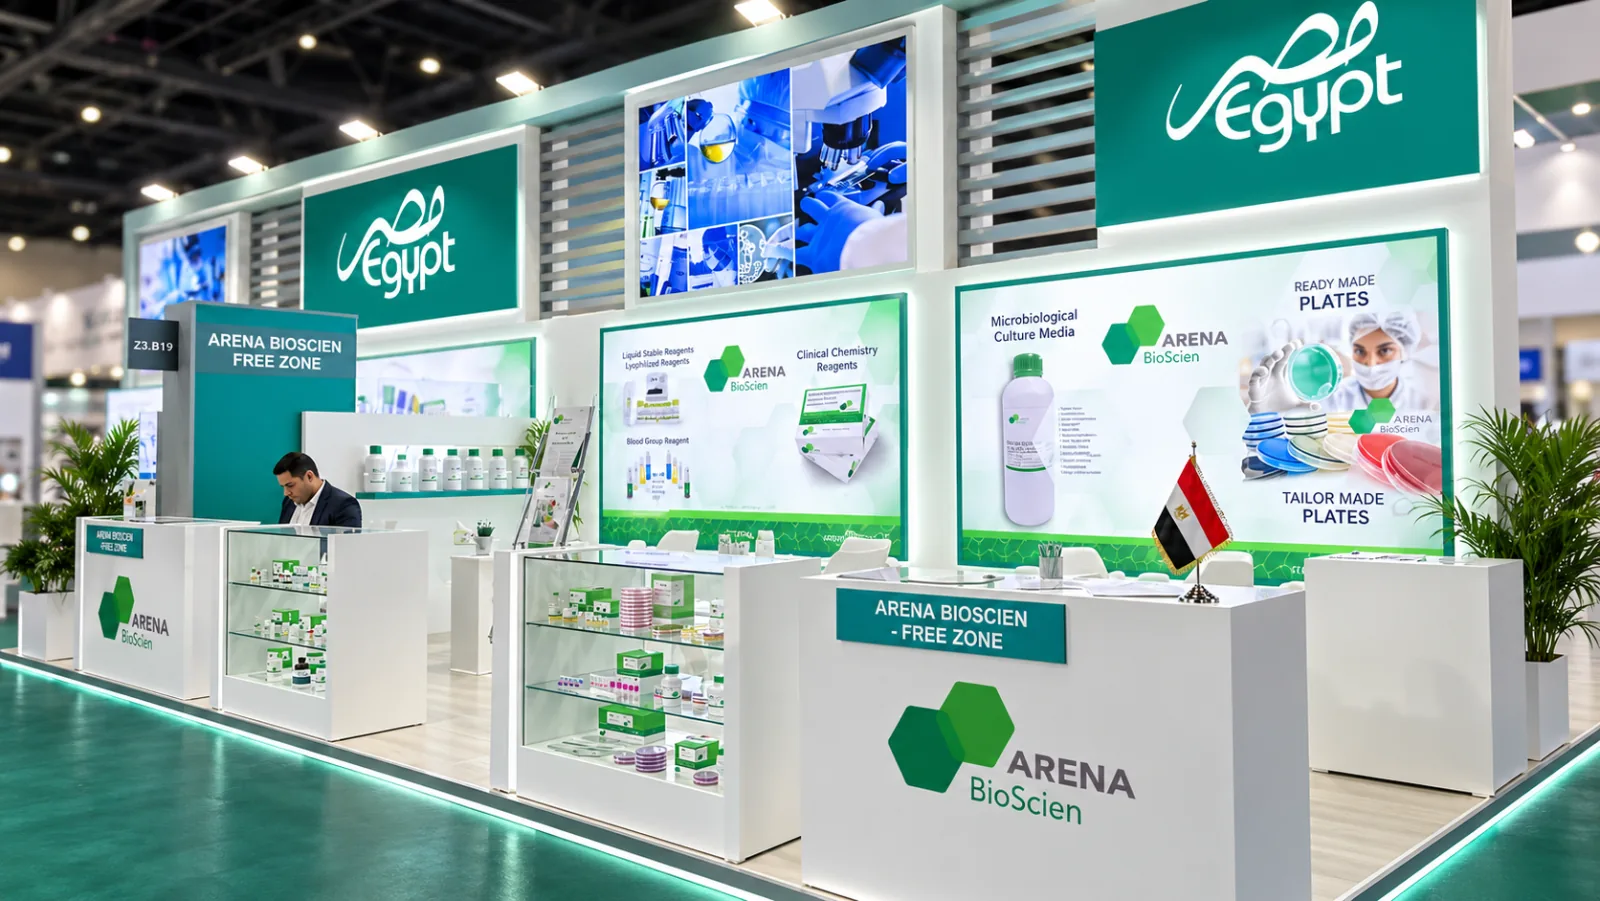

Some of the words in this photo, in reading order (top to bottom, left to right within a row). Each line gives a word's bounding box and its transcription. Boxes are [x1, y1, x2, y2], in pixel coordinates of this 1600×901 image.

[1215, 53, 1403, 153] Egypt
[362, 231, 456, 299] Egypt
[1294, 278, 1335, 292] READY
[1337, 274, 1376, 288] MADE
[1299, 291, 1370, 311] PLATES
[991, 309, 1078, 327] Microbiological
[208, 332, 265, 349] ARENA
[269, 336, 342, 354] BIOSCIEN
[994, 328, 1036, 343] Culture
[1039, 326, 1075, 339] Media
[1162, 331, 1229, 348] ARENA
[133, 340, 174, 352] Z3.B19
[622, 350, 642, 360] Liquid
[643, 348, 663, 358] Stable
[664, 346, 694, 356] Reagents
[796, 348, 829, 360] Clinical
[831, 345, 878, 358] Chemistry
[233, 353, 275, 368] FREE
[279, 355, 322, 370] ZONE
[660, 358, 690, 367] Reagents
[1143, 350, 1200, 364] BioScien
[742, 366, 786, 380] ARENA
[817, 361, 858, 373] Reagents
[730, 380, 768, 392] BioScien
[1393, 415, 1433, 424] ARENA
[1380, 425, 1420, 434] BioScien
[626, 437, 644, 445] Blood
[644, 437, 663, 446] Group
[664, 437, 690, 446] Reagent
[1282, 491, 1334, 505] TAILOR
[1338, 492, 1385, 506] MADE
[1302, 508, 1370, 525] PLATES
[875, 600, 936, 620] ARENA
[940, 604, 1028, 628] BIOSCIEN
[131, 613, 169, 636] ARENA
[121, 629, 152, 650] BioScien
[902, 624, 947, 644] FREE
[952, 628, 1003, 650] ZONE
[1007, 750, 1136, 799] ARENA
[970, 776, 1082, 825] BioScien
